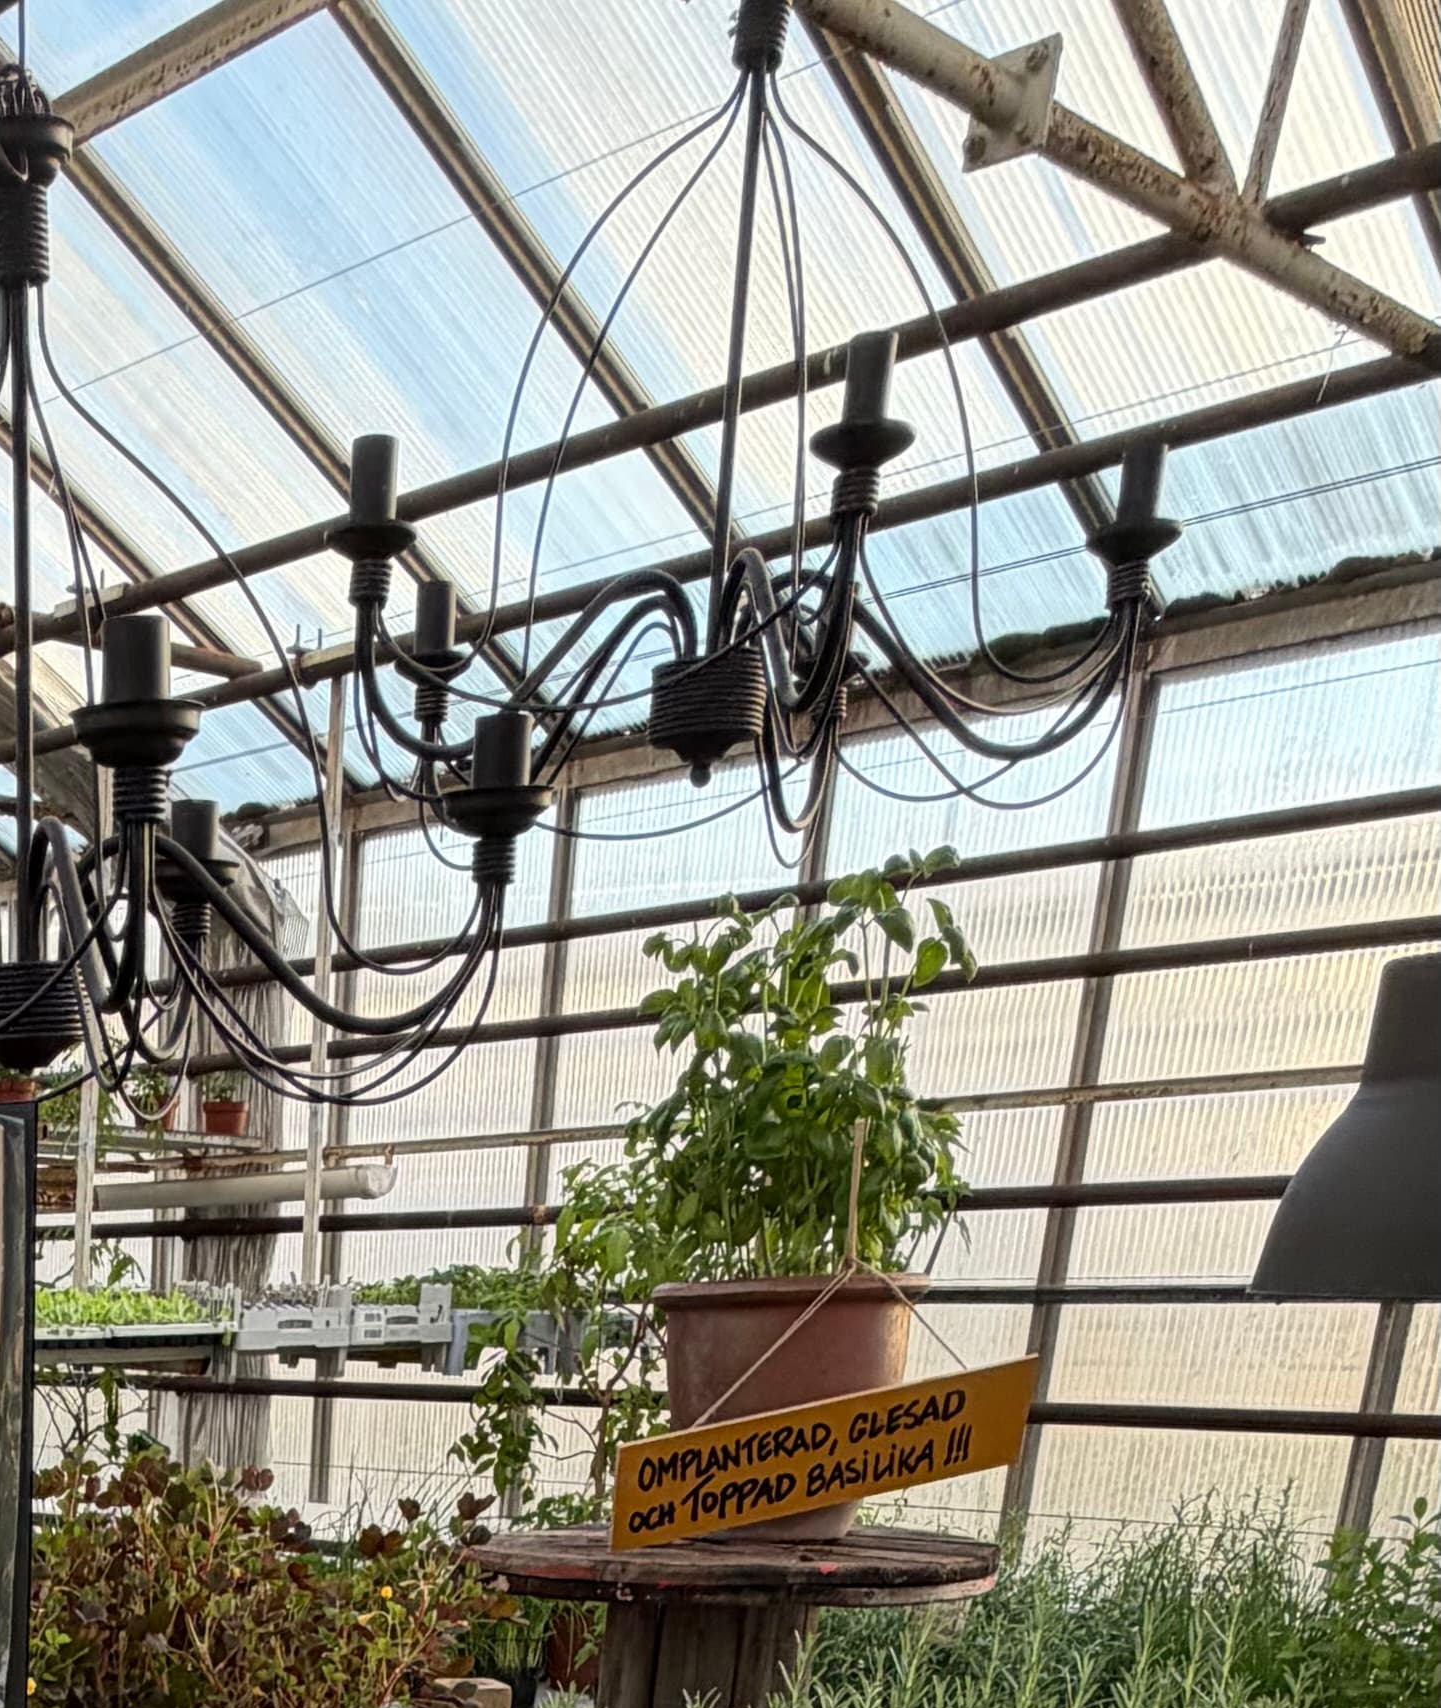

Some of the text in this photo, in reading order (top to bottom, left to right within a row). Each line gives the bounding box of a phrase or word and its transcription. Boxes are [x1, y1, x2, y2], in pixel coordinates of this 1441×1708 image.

[627, 1500, 676, 1534] OCH
[681, 1472, 798, 1522] TOPPAD
[805, 1440, 935, 1498] BASILIKA
[638, 1389, 967, 1492] OMPLANTERAD, GLESAD
